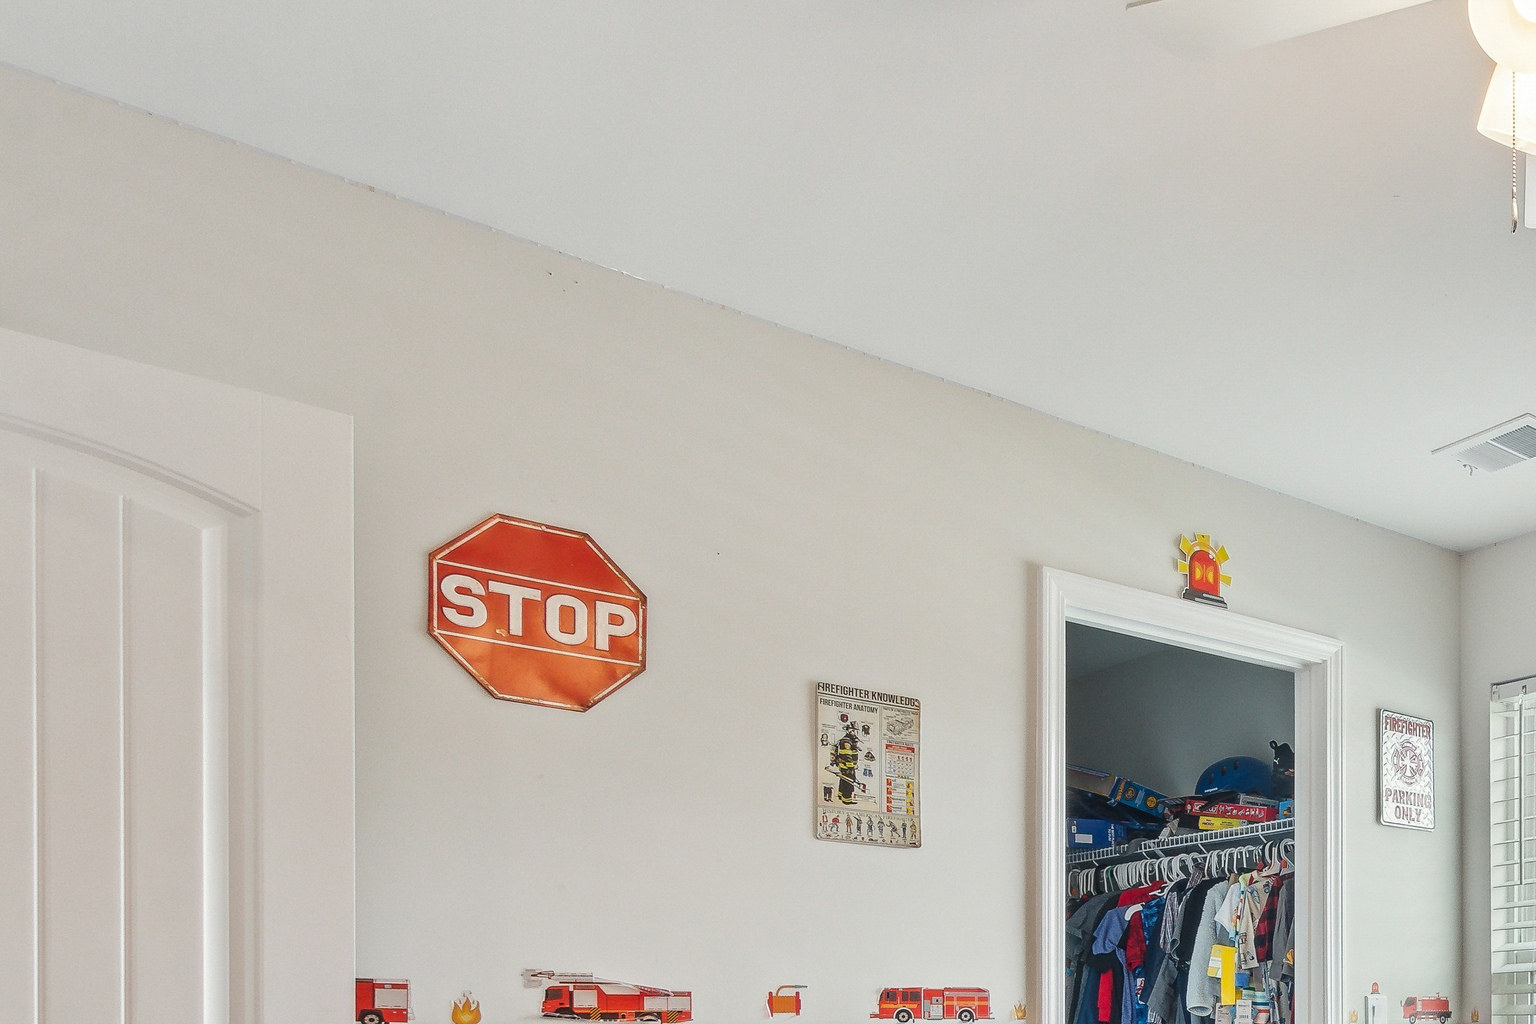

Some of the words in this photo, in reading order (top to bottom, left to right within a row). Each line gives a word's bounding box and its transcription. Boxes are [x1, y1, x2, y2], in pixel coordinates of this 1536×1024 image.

[440, 574, 638, 652] STOP
[817, 682, 870, 700] FIREFIGHTER
[871, 691, 920, 707] KNOWLEDG
[819, 698, 853, 710] FIREFIGHTER
[853, 703, 879, 714] ANATOMY
[1384, 716, 1431, 739] FIREFIGHTER
[1385, 787, 1432, 809] PARKING
[1394, 805, 1422, 822] ONLY
